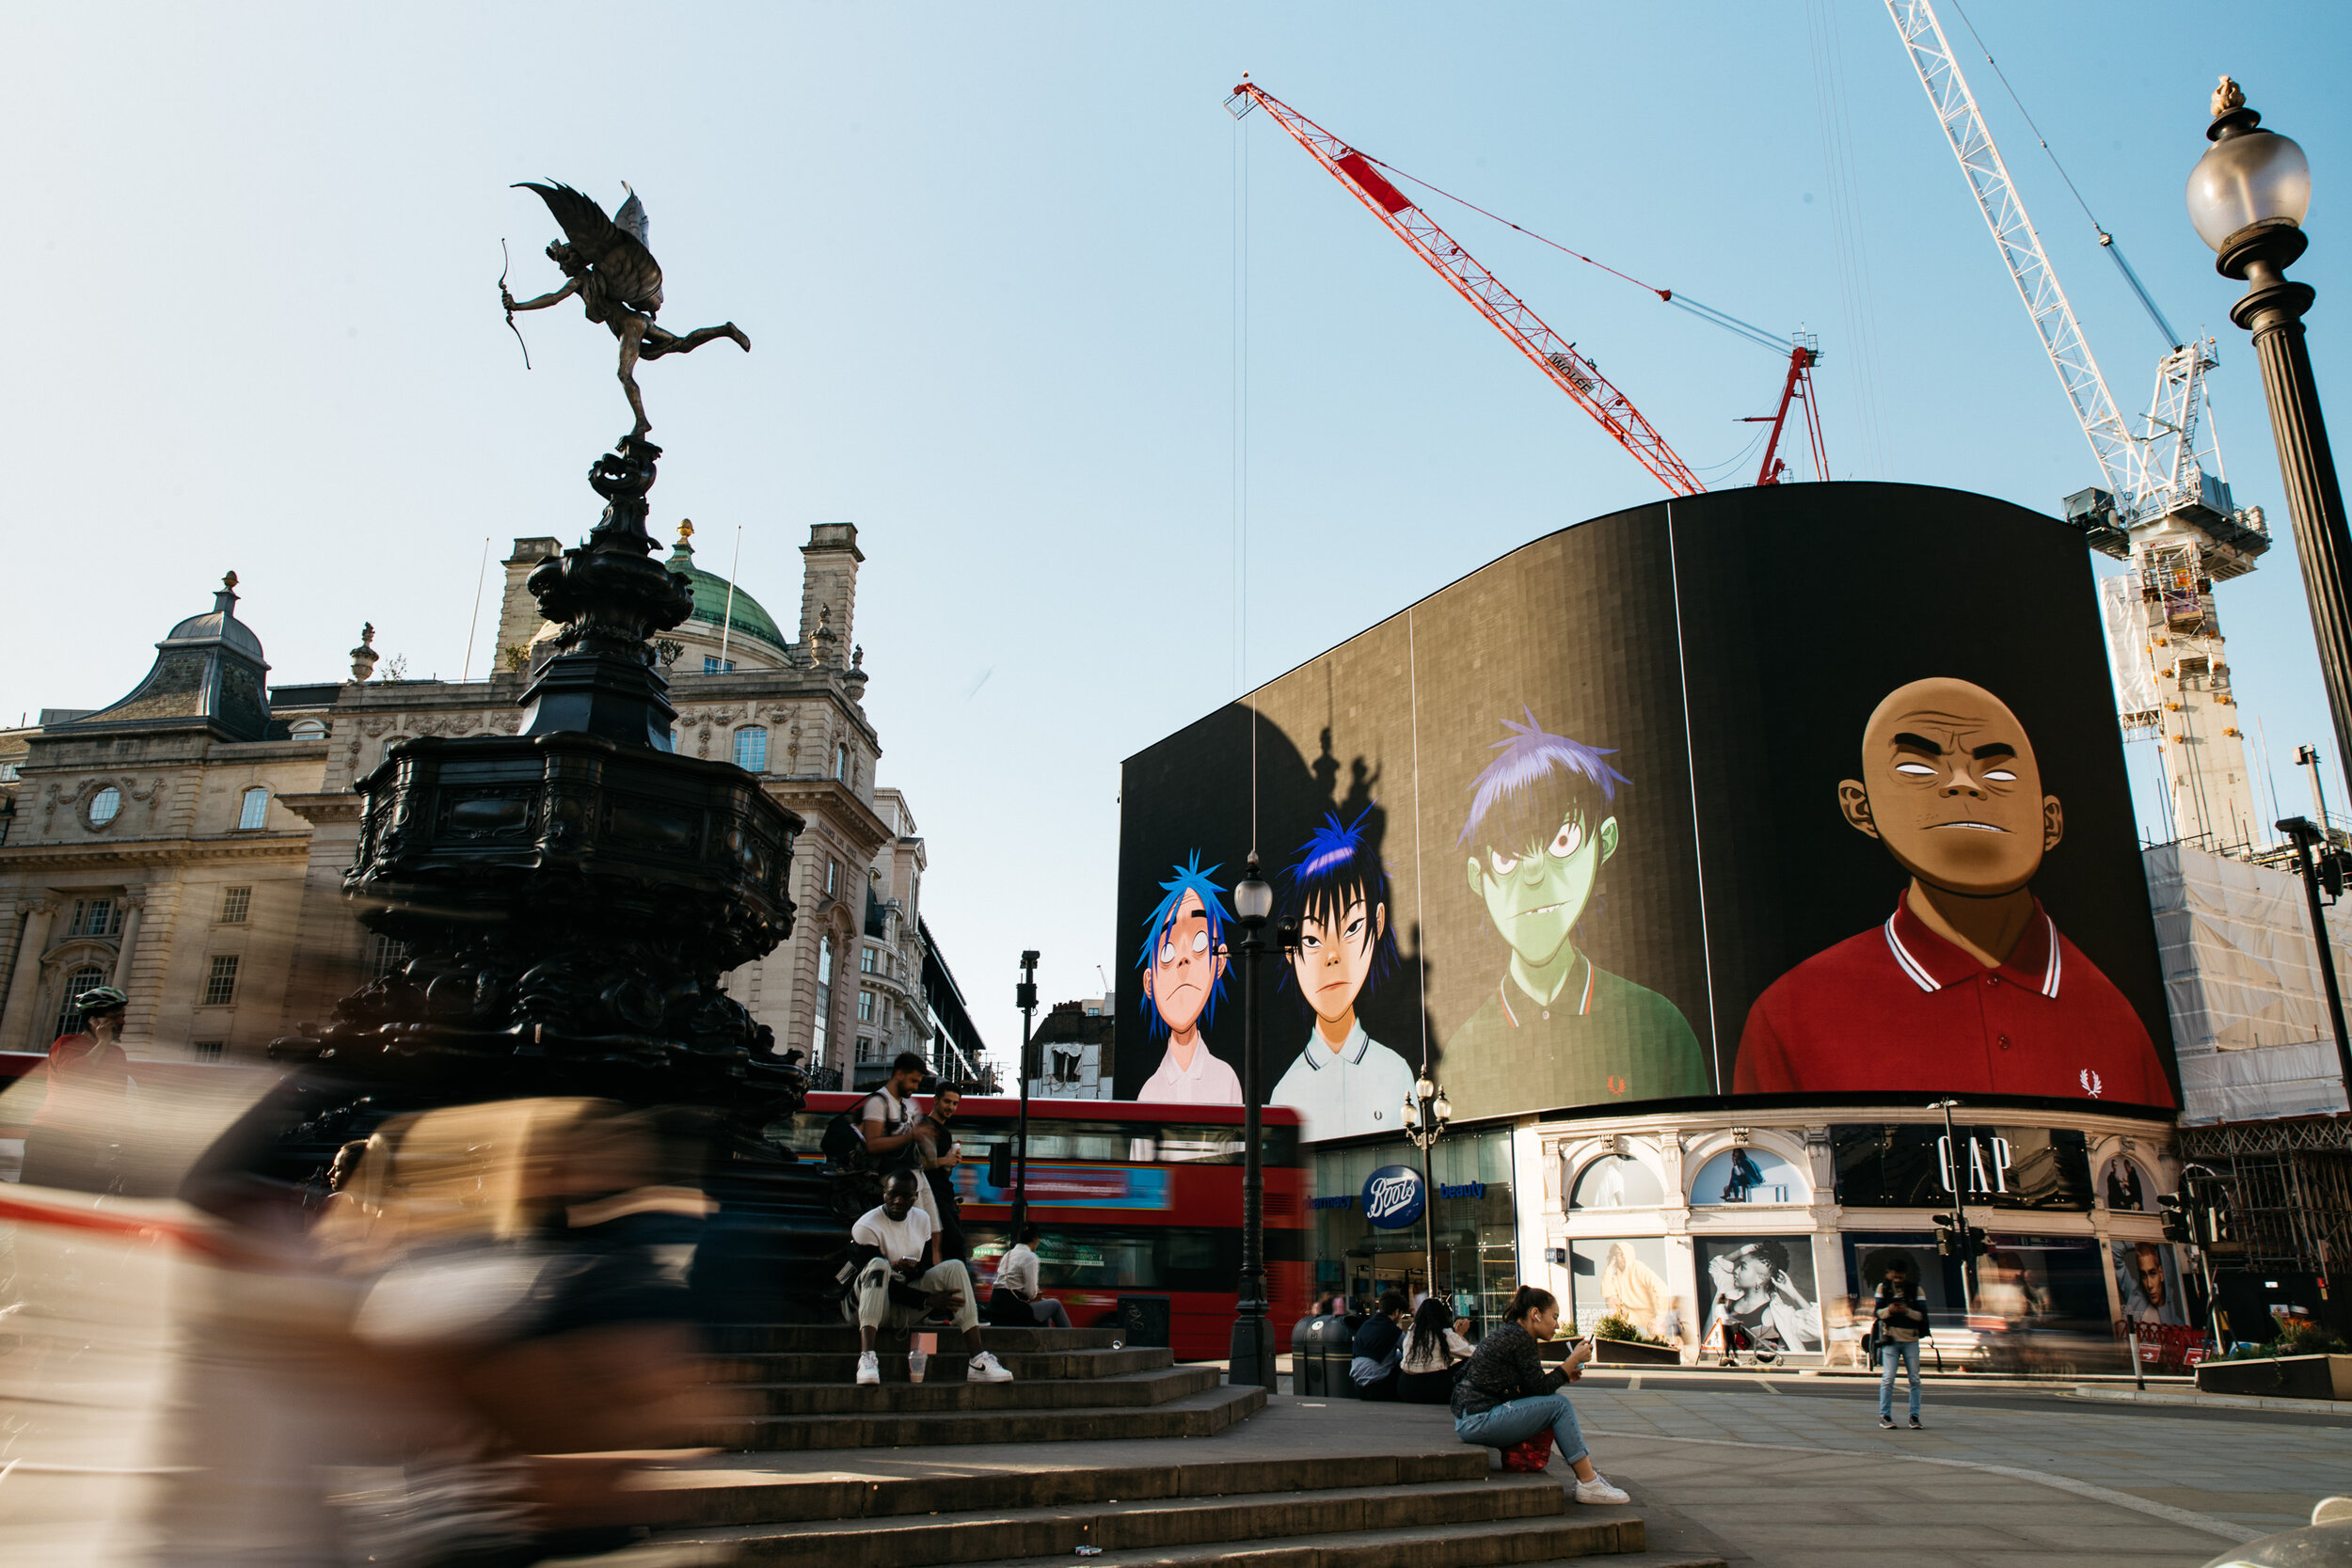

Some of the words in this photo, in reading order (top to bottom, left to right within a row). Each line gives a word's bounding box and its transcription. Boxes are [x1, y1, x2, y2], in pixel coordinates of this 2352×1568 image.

[1938, 1135, 2011, 1194] GAP
[1367, 1176, 1416, 1219] Boots
[1440, 1180, 1484, 1199] beauty
